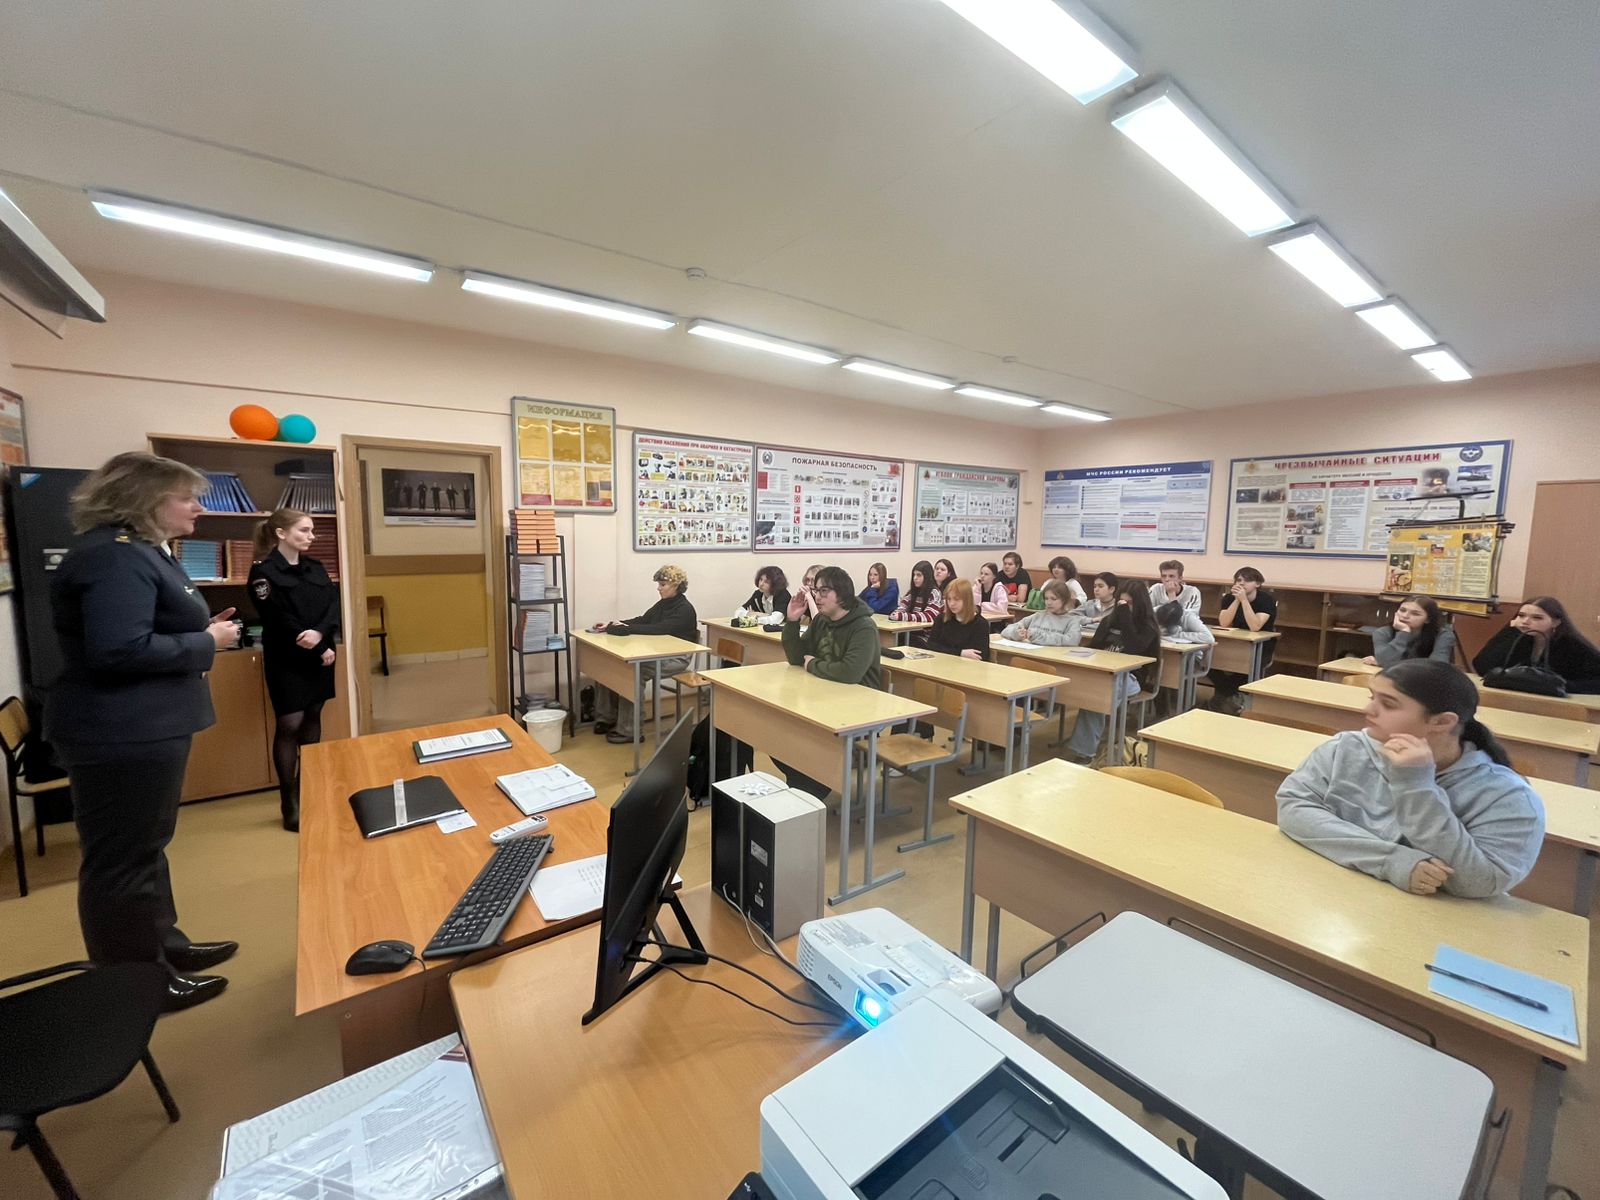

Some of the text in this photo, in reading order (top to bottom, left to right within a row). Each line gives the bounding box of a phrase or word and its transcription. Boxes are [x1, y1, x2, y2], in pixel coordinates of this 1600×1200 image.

[527, 404, 603, 420] ИНФОРМАЦИЯ
[791, 457, 877, 471] ПОЖАРНАЯ БЕЗОПАСНОСТЬ
[1274, 453, 1442, 470] ЧРЕЗВЫЧАЙНЫЕ СИТУАЦИИ
[1124, 467, 1172, 475] РЕКОМЕНДУЕТ
[827, 973, 842, 991] EPSON
